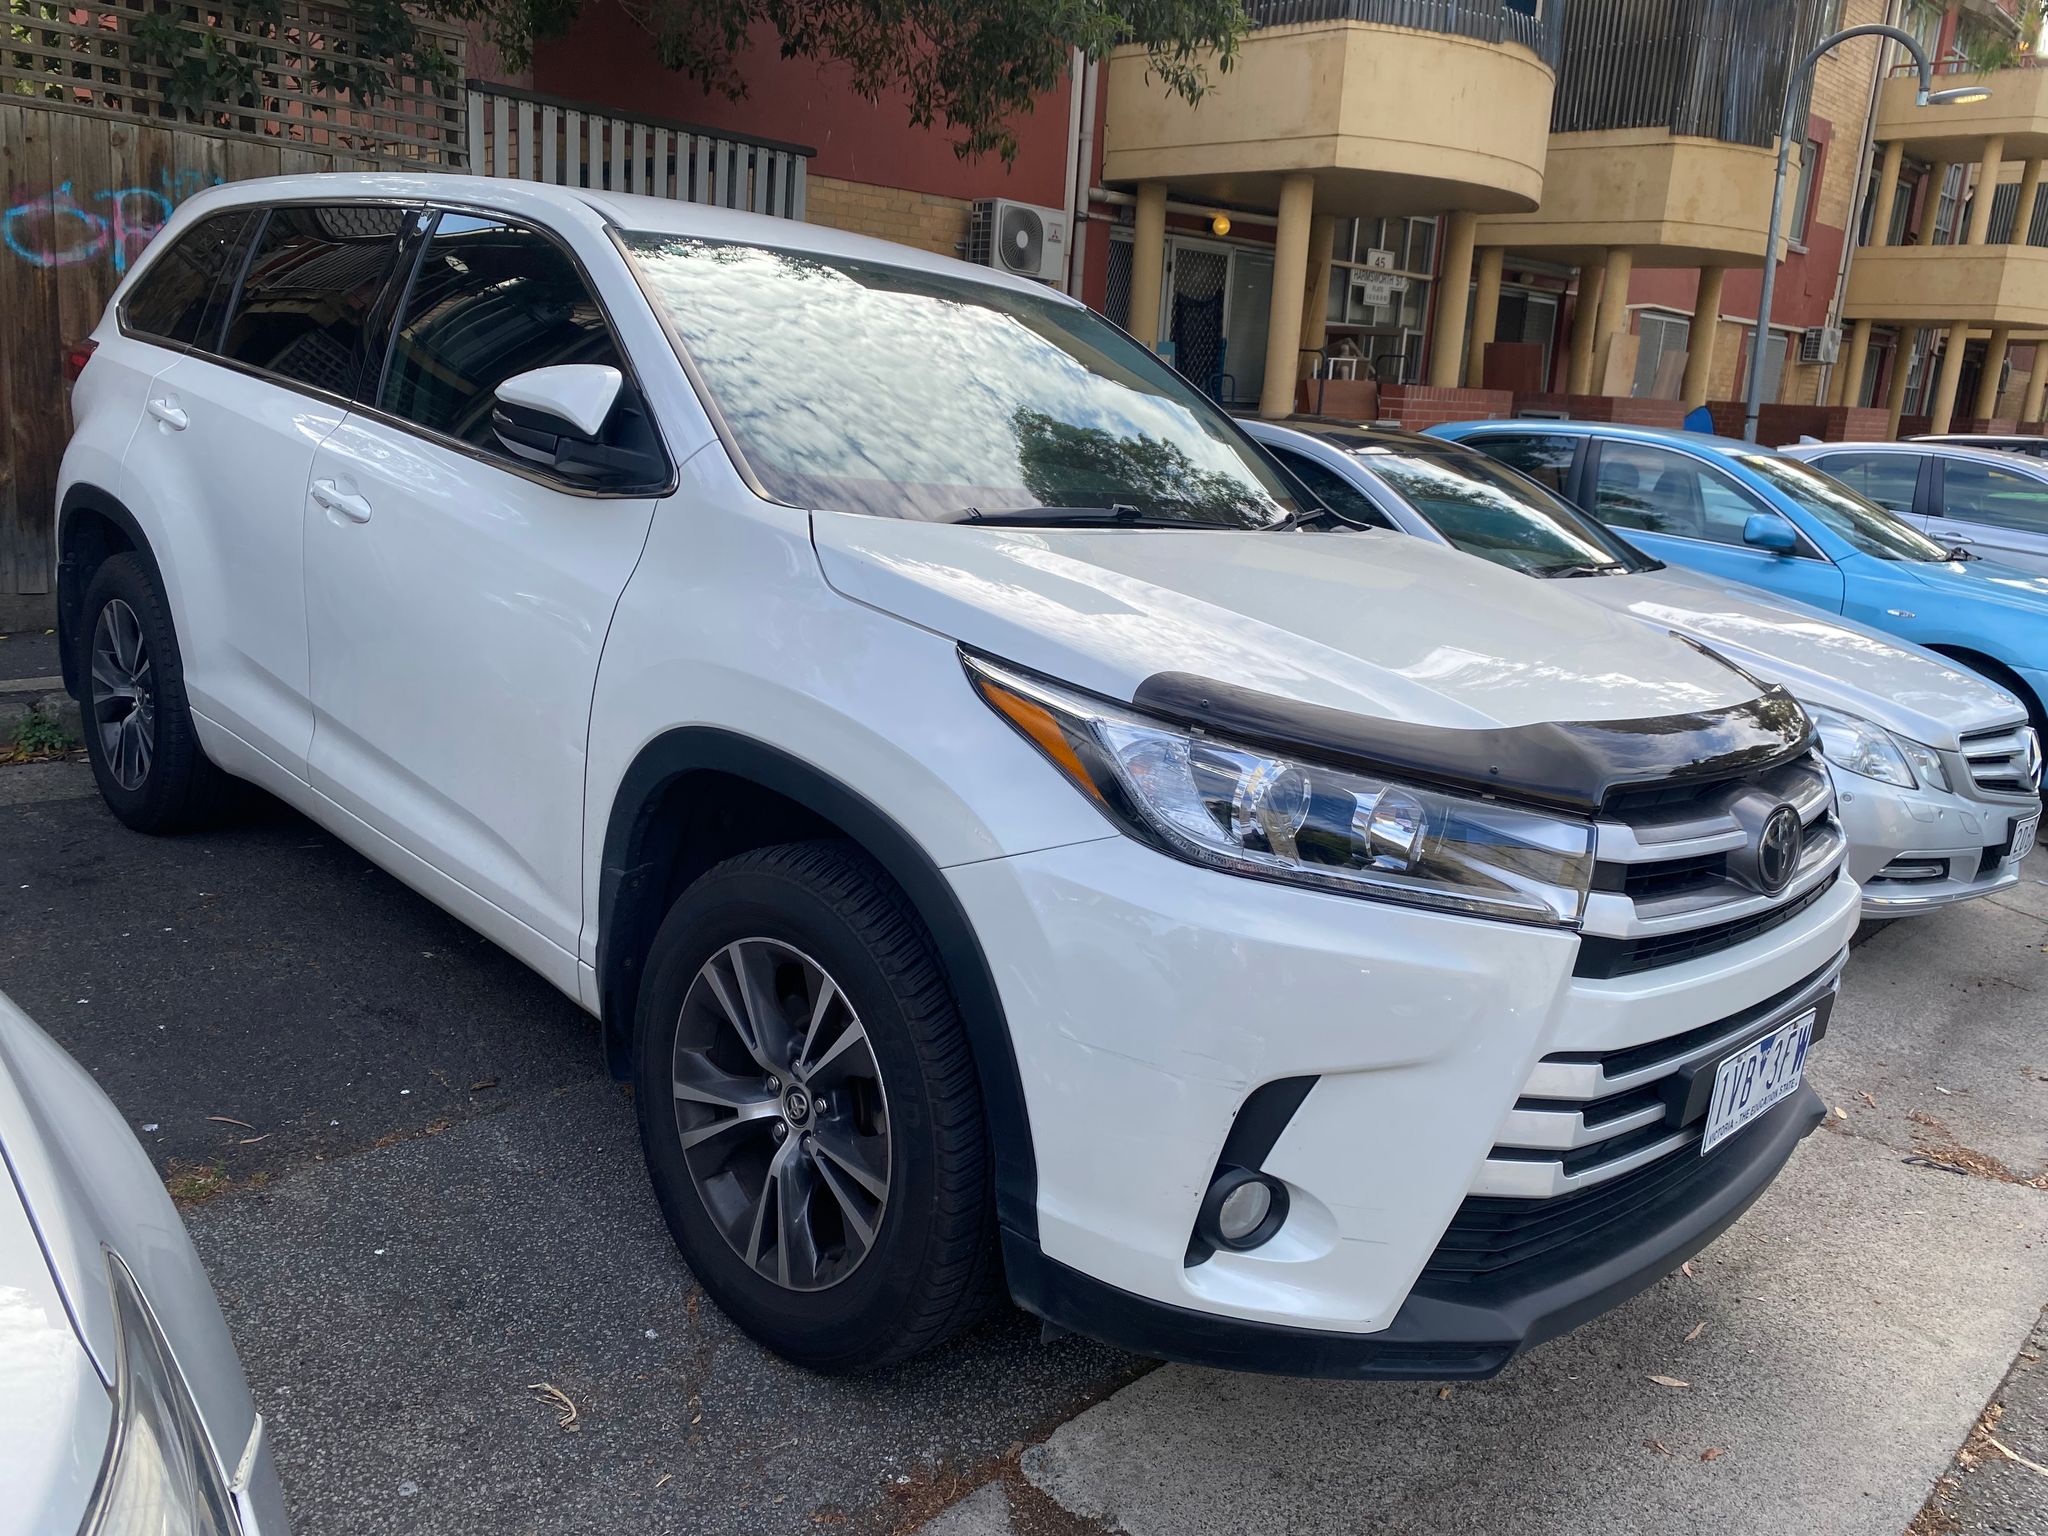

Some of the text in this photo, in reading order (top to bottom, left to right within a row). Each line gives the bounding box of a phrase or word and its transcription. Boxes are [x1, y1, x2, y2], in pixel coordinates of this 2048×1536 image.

[1375, 257, 1385, 268] 45
[1708, 1120, 1734, 1145] VICTORIA
[1739, 1109, 1750, 1124] THE
[1750, 1090, 1778, 1120] EDUCATION
[1779, 1079, 1795, 1099] STATE
